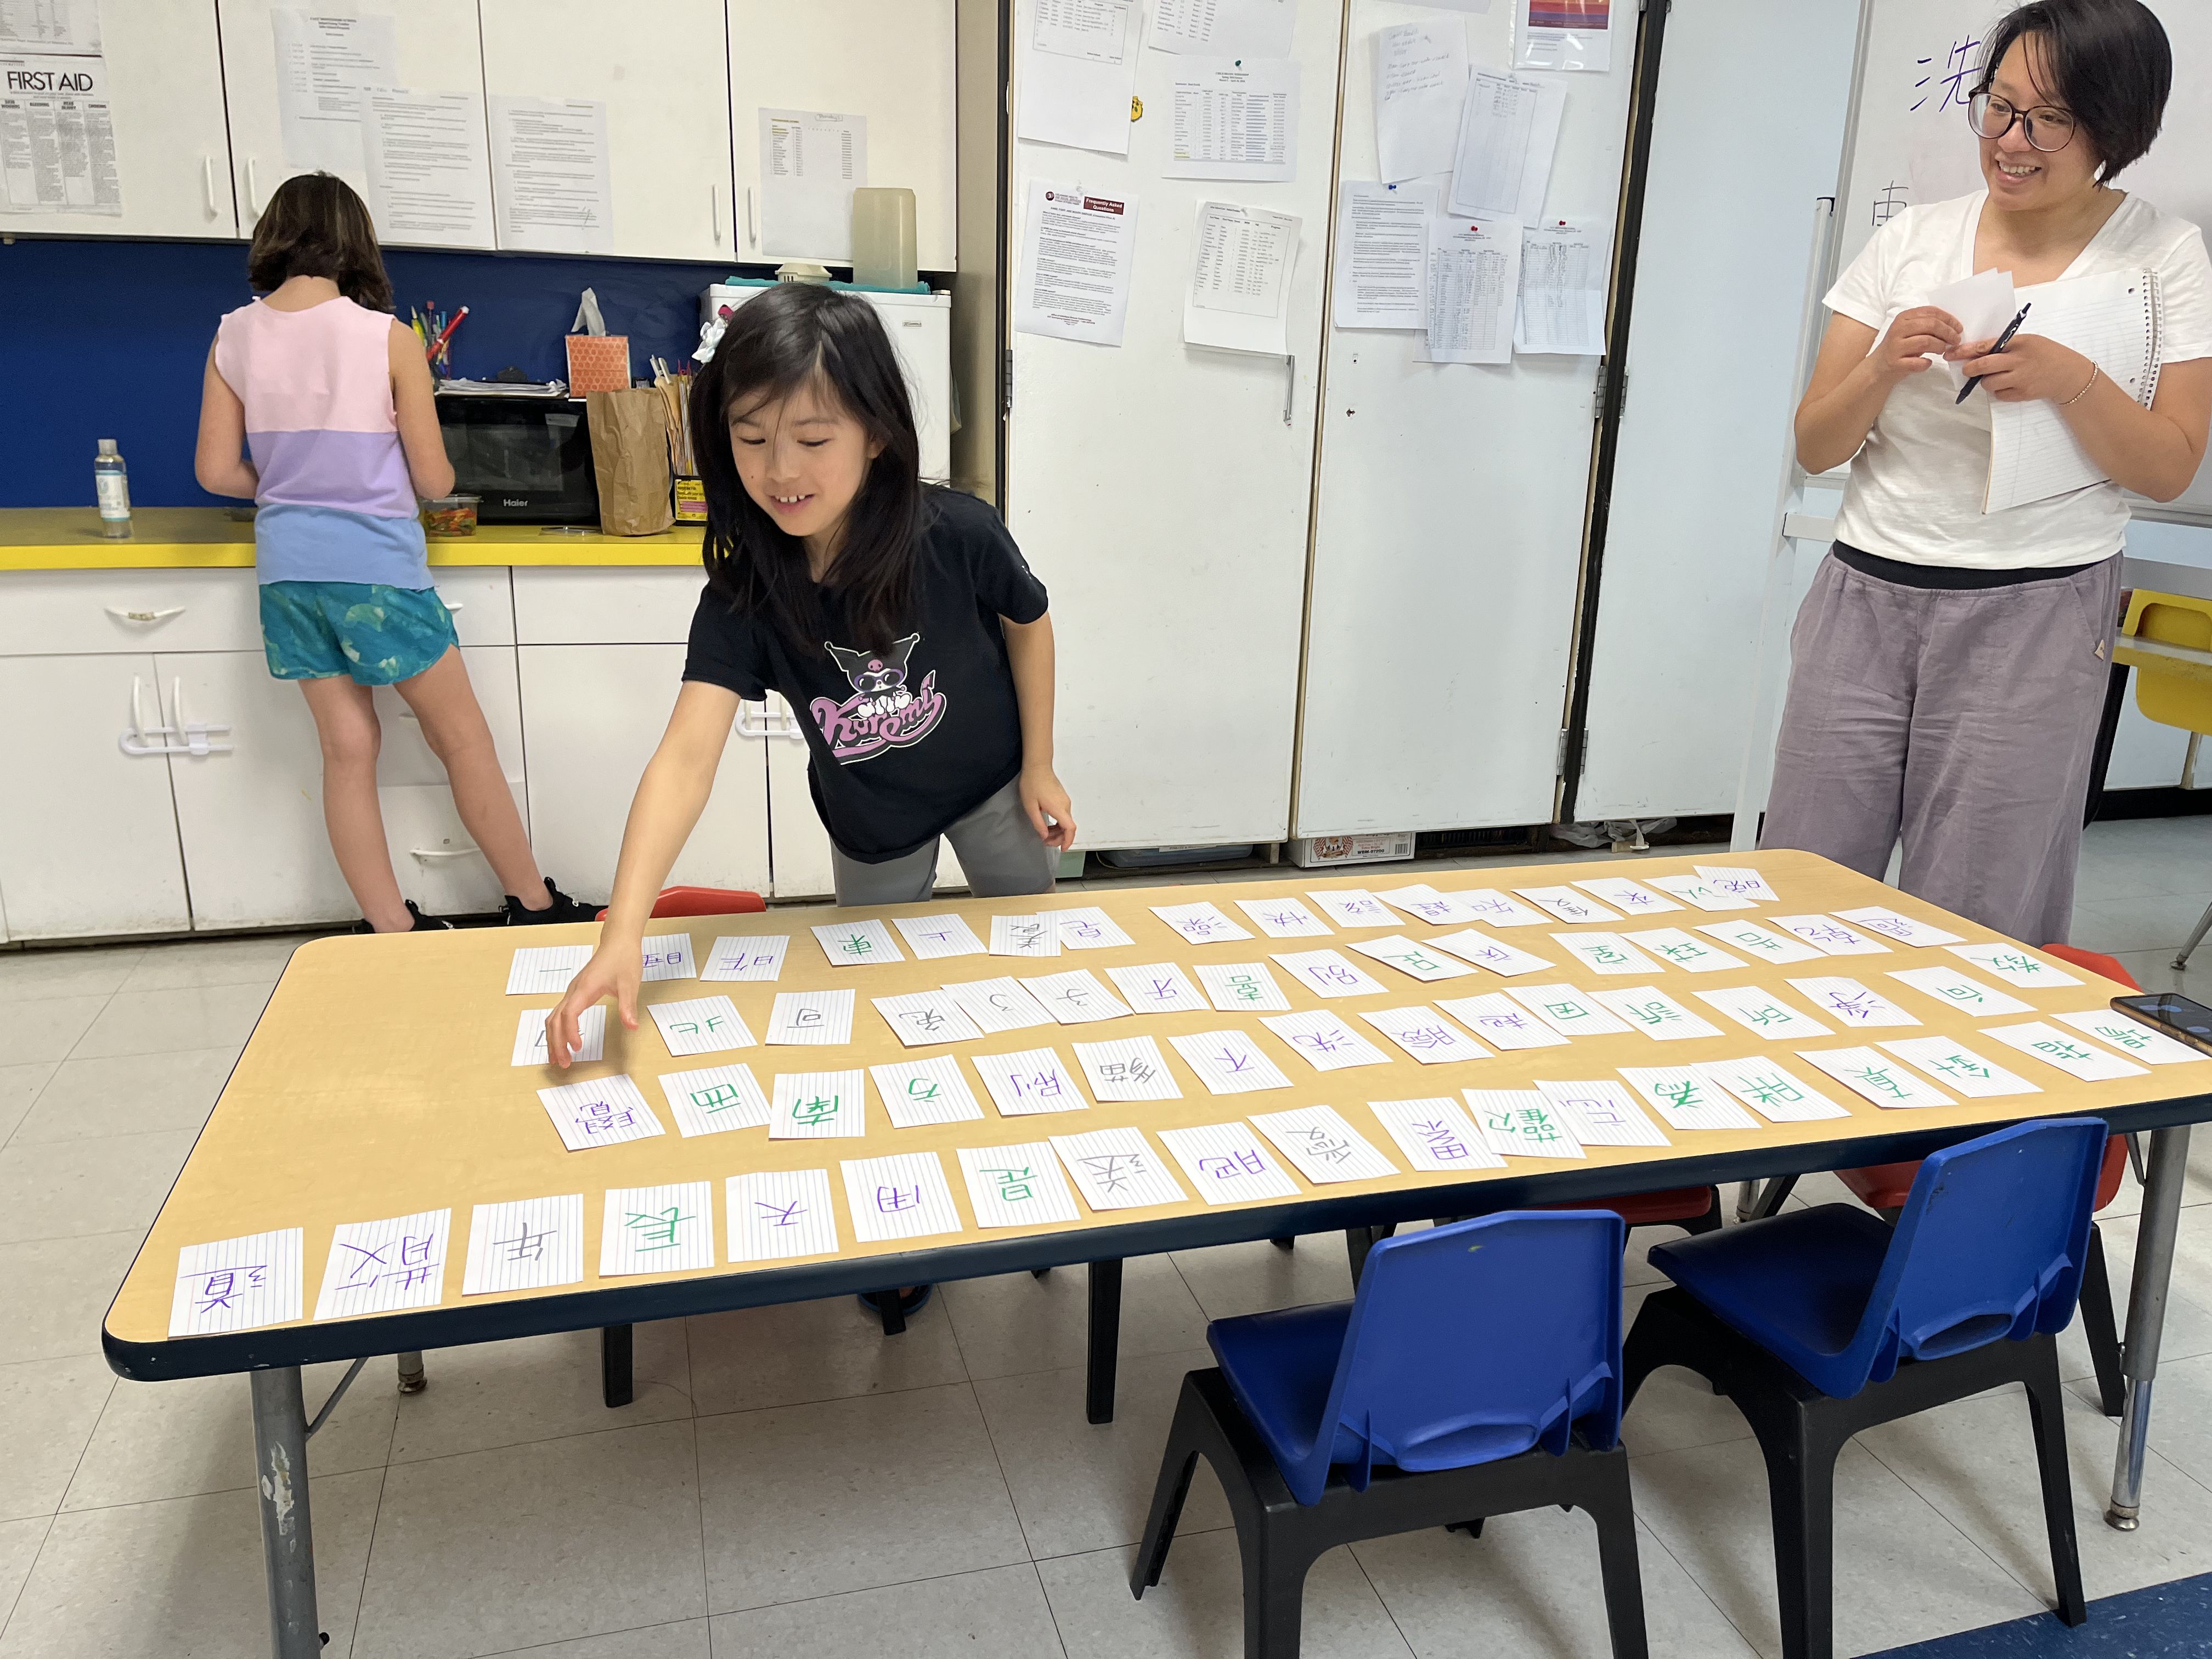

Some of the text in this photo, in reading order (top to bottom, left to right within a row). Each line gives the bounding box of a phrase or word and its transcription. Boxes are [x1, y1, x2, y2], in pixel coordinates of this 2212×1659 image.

[7, 71, 93, 91] FIRST AID
[1910, 34, 1983, 112] 洗
[1086, 198, 1108, 207] Frequently
[1672, 887, 1713, 901] 以
[1713, 880, 1760, 893] 晚
[1339, 901, 1380, 914] 該
[1471, 900, 1514, 913] 知
[1538, 899, 1588, 916] 隻
[1614, 891, 1654, 905] 來
[1176, 916, 1227, 935] 澡
[1263, 912, 1307, 927] 快
[1857, 919, 1912, 936] 過
[837, 934, 872, 956] 東
[918, 931, 952, 941] 上
[1009, 924, 1048, 948] 養
[1735, 933, 1782, 950] 告
[1794, 924, 1860, 944] 乾
[719, 953, 773, 971] 昨
[1383, 951, 1441, 970] 足
[1476, 946, 1511, 961] 床
[1581, 946, 1628, 964] 室
[1655, 943, 1708, 962] 球
[1970, 955, 2041, 973] 教
[1308, 966, 1358, 986] 別
[1056, 989, 1088, 1006] 子
[1144, 978, 1177, 1000] 牙
[1224, 975, 1263, 1001] 喜
[1936, 985, 1983, 1002] 向
[1543, 1001, 1590, 1019] 因
[1625, 1002, 1682, 1024] 訴
[1738, 1005, 1793, 1025] 所
[1829, 992, 1885, 1018] 淨
[669, 1014, 725, 1034] 北
[787, 1008, 824, 1028] 可
[899, 1009, 945, 1031] 兔
[1479, 1013, 1527, 1029] 起
[1292, 1030, 1353, 1052] 洗
[1391, 1025, 1456, 1048] 臉
[2095, 1027, 2152, 1048] 場
[1214, 1048, 1254, 1073] 不
[2031, 1041, 2093, 1060] 指
[1099, 1057, 1156, 1084] 貓
[1928, 1055, 1990, 1078] 針
[909, 1077, 941, 1102] 方
[1010, 1069, 1062, 1097] 刷
[1738, 1073, 1805, 1107] 胖
[1843, 1067, 1913, 1099] 真
[690, 1084, 741, 1114] 西
[1654, 1080, 1703, 1109] 為
[575, 1099, 636, 1134] 覺
[792, 1092, 838, 1126] 南
[1558, 1099, 1626, 1126] 忘
[1484, 1109, 1562, 1143] 歡
[1285, 1127, 1351, 1164] 愛
[1412, 1120, 1469, 1160] 累
[1077, 1154, 1147, 1193] 送
[1199, 1149, 1266, 1179] 肥
[979, 1167, 1037, 1201] 是
[877, 1182, 919, 1212] 用
[754, 1201, 808, 1226] 天
[624, 1207, 696, 1255] 長
[493, 1221, 557, 1268] 年
[335, 1230, 442, 1299] 散
[180, 1262, 268, 1314] 道
